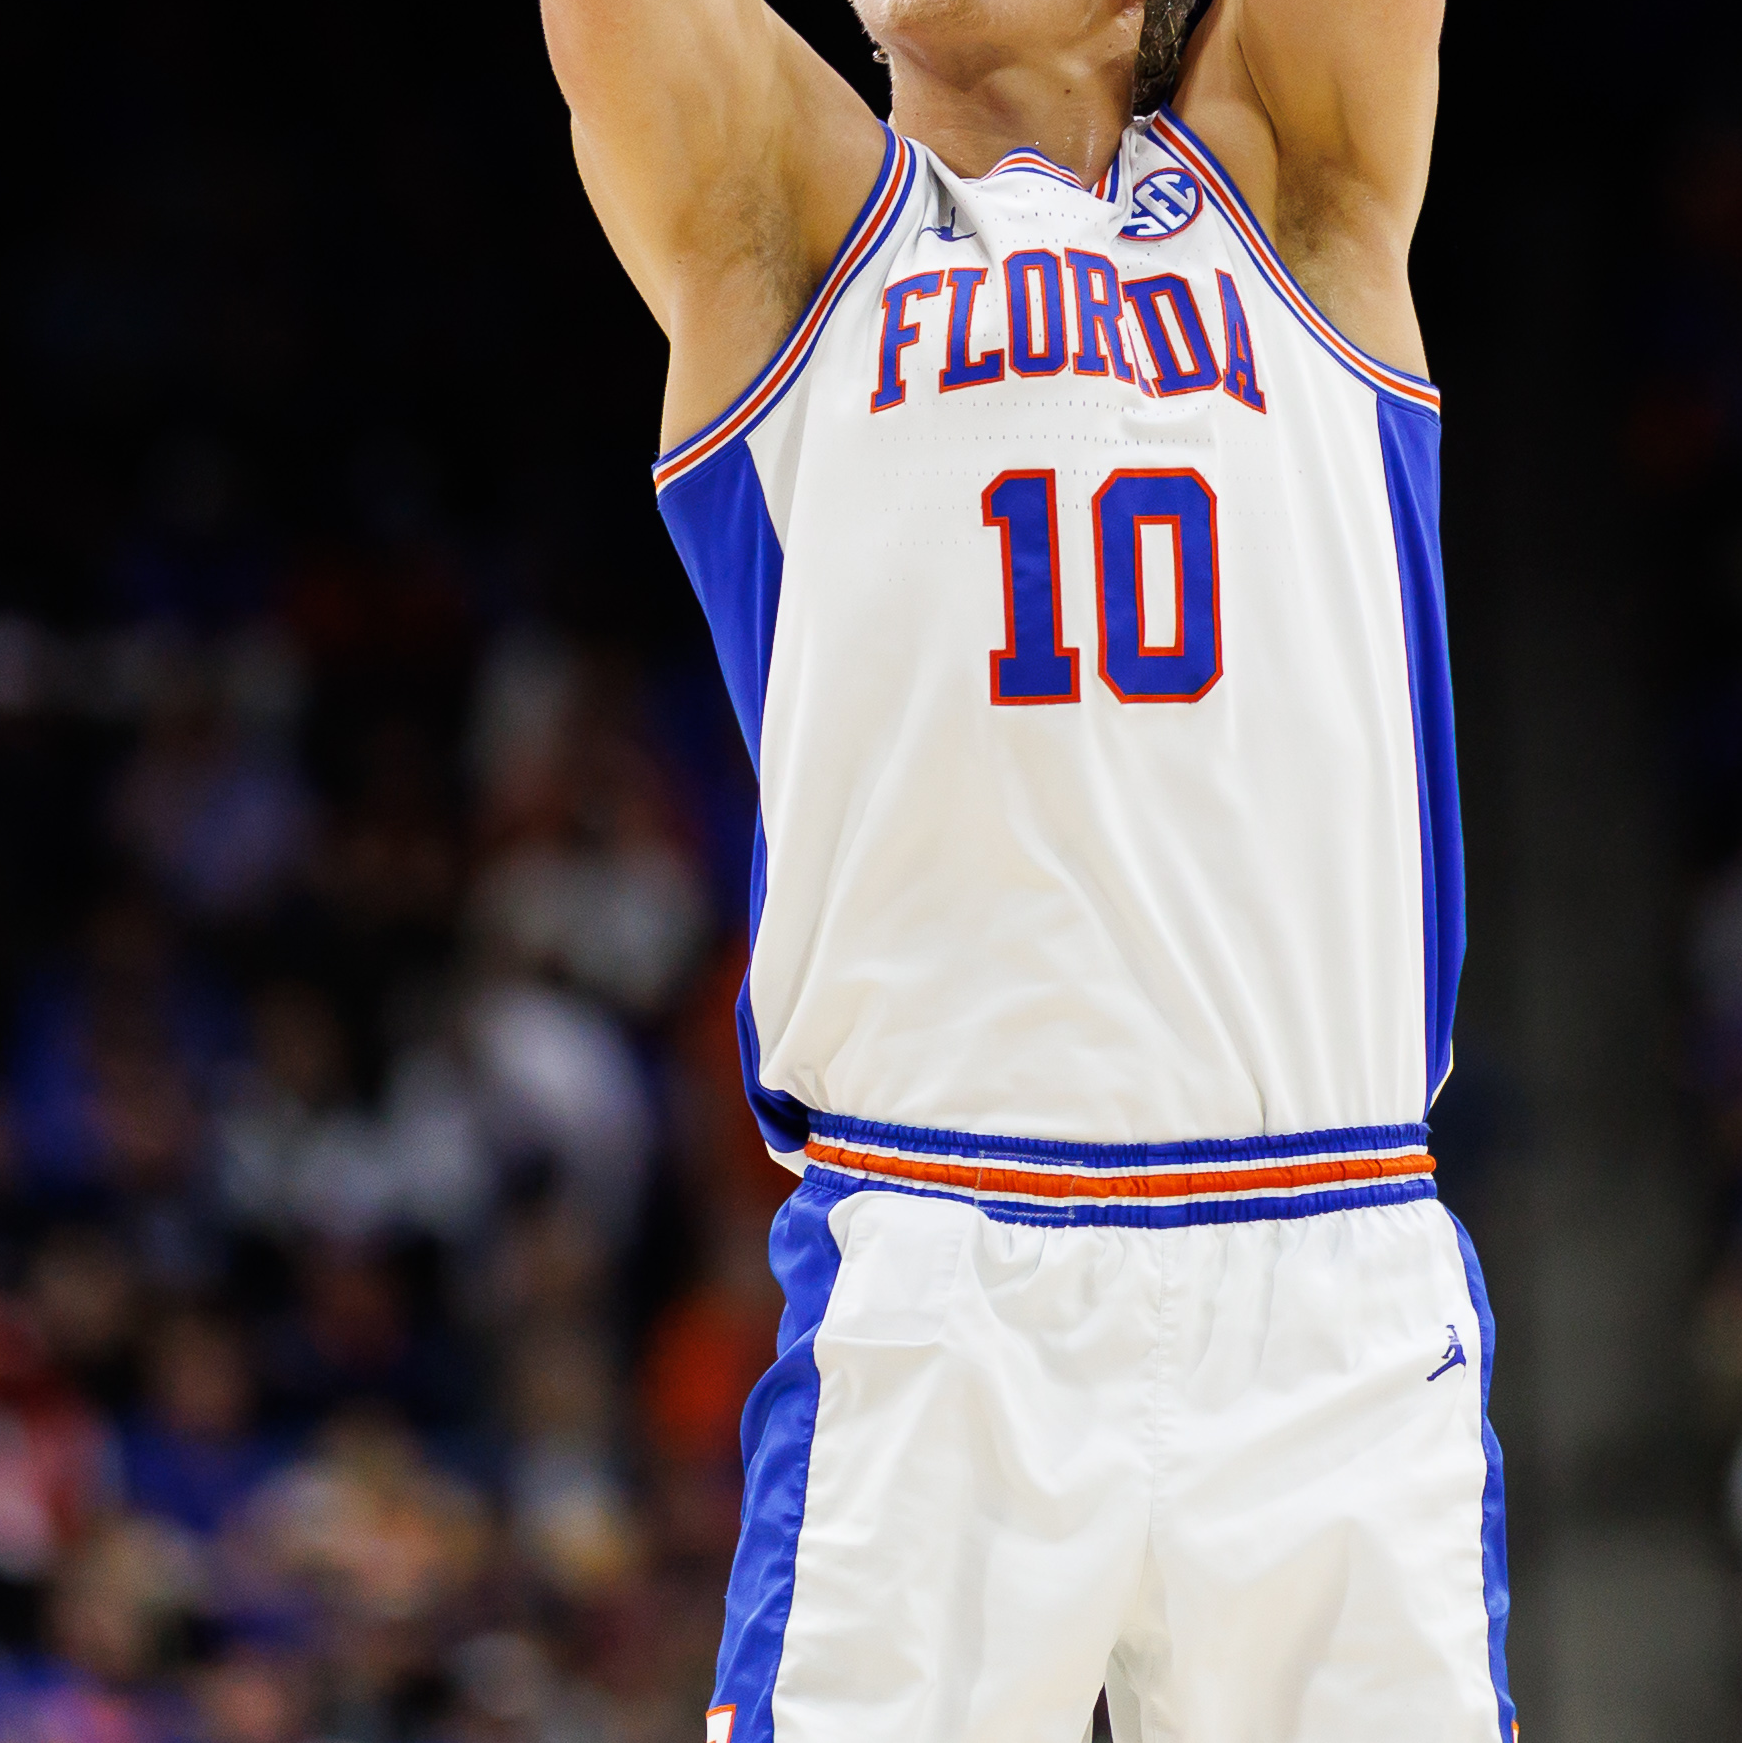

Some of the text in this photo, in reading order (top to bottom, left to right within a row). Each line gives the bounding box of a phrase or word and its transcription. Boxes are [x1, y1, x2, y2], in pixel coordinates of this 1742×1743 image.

[1123, 173, 1197, 236] SEC
[870, 247, 1267, 415] FLORDA
[981, 467, 1224, 706] 10
